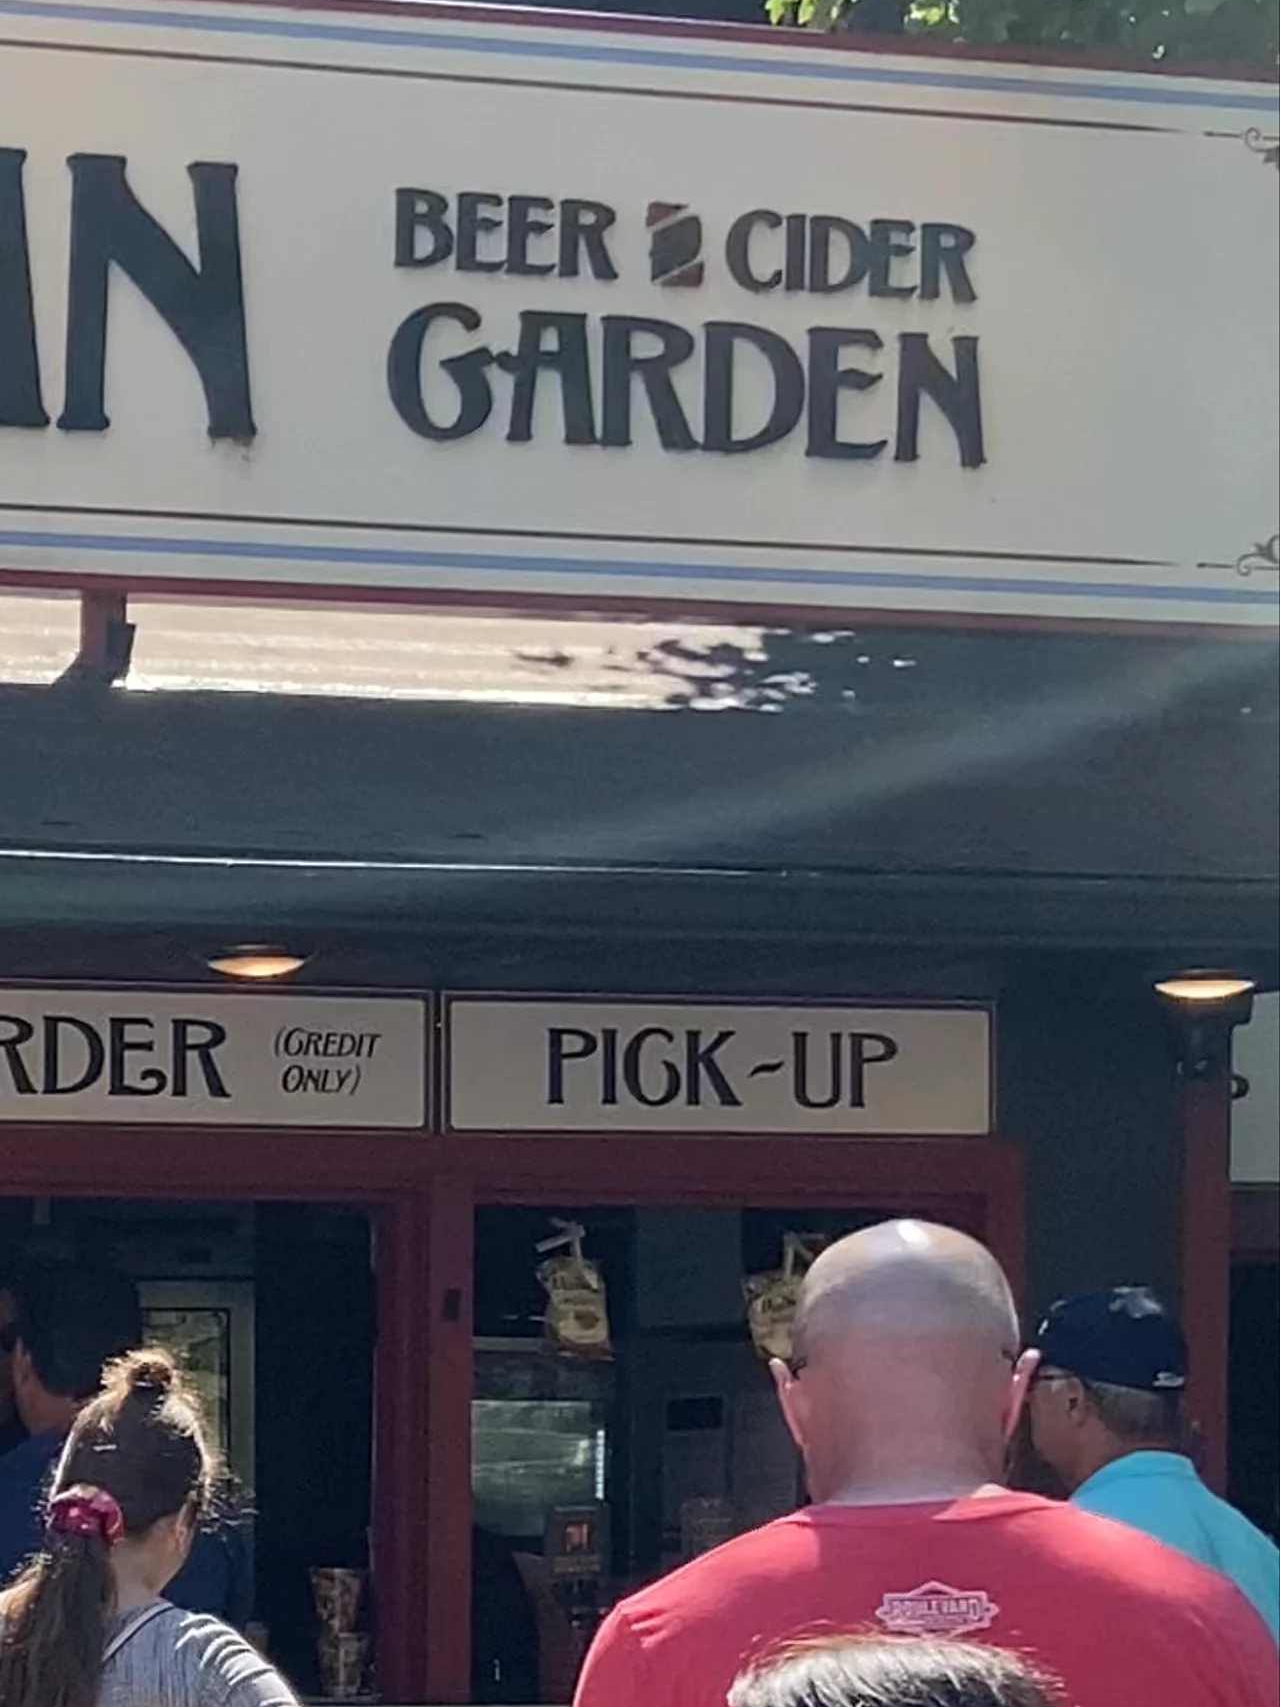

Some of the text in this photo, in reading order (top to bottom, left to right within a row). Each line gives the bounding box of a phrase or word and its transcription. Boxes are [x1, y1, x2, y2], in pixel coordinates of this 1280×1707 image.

[393, 187, 978, 304] BEER CIDER
[386, 301, 988, 470] GARDEN
[274, 1025, 382, 1058] (CREDIT
[282, 1064, 361, 1096] ONLY)
